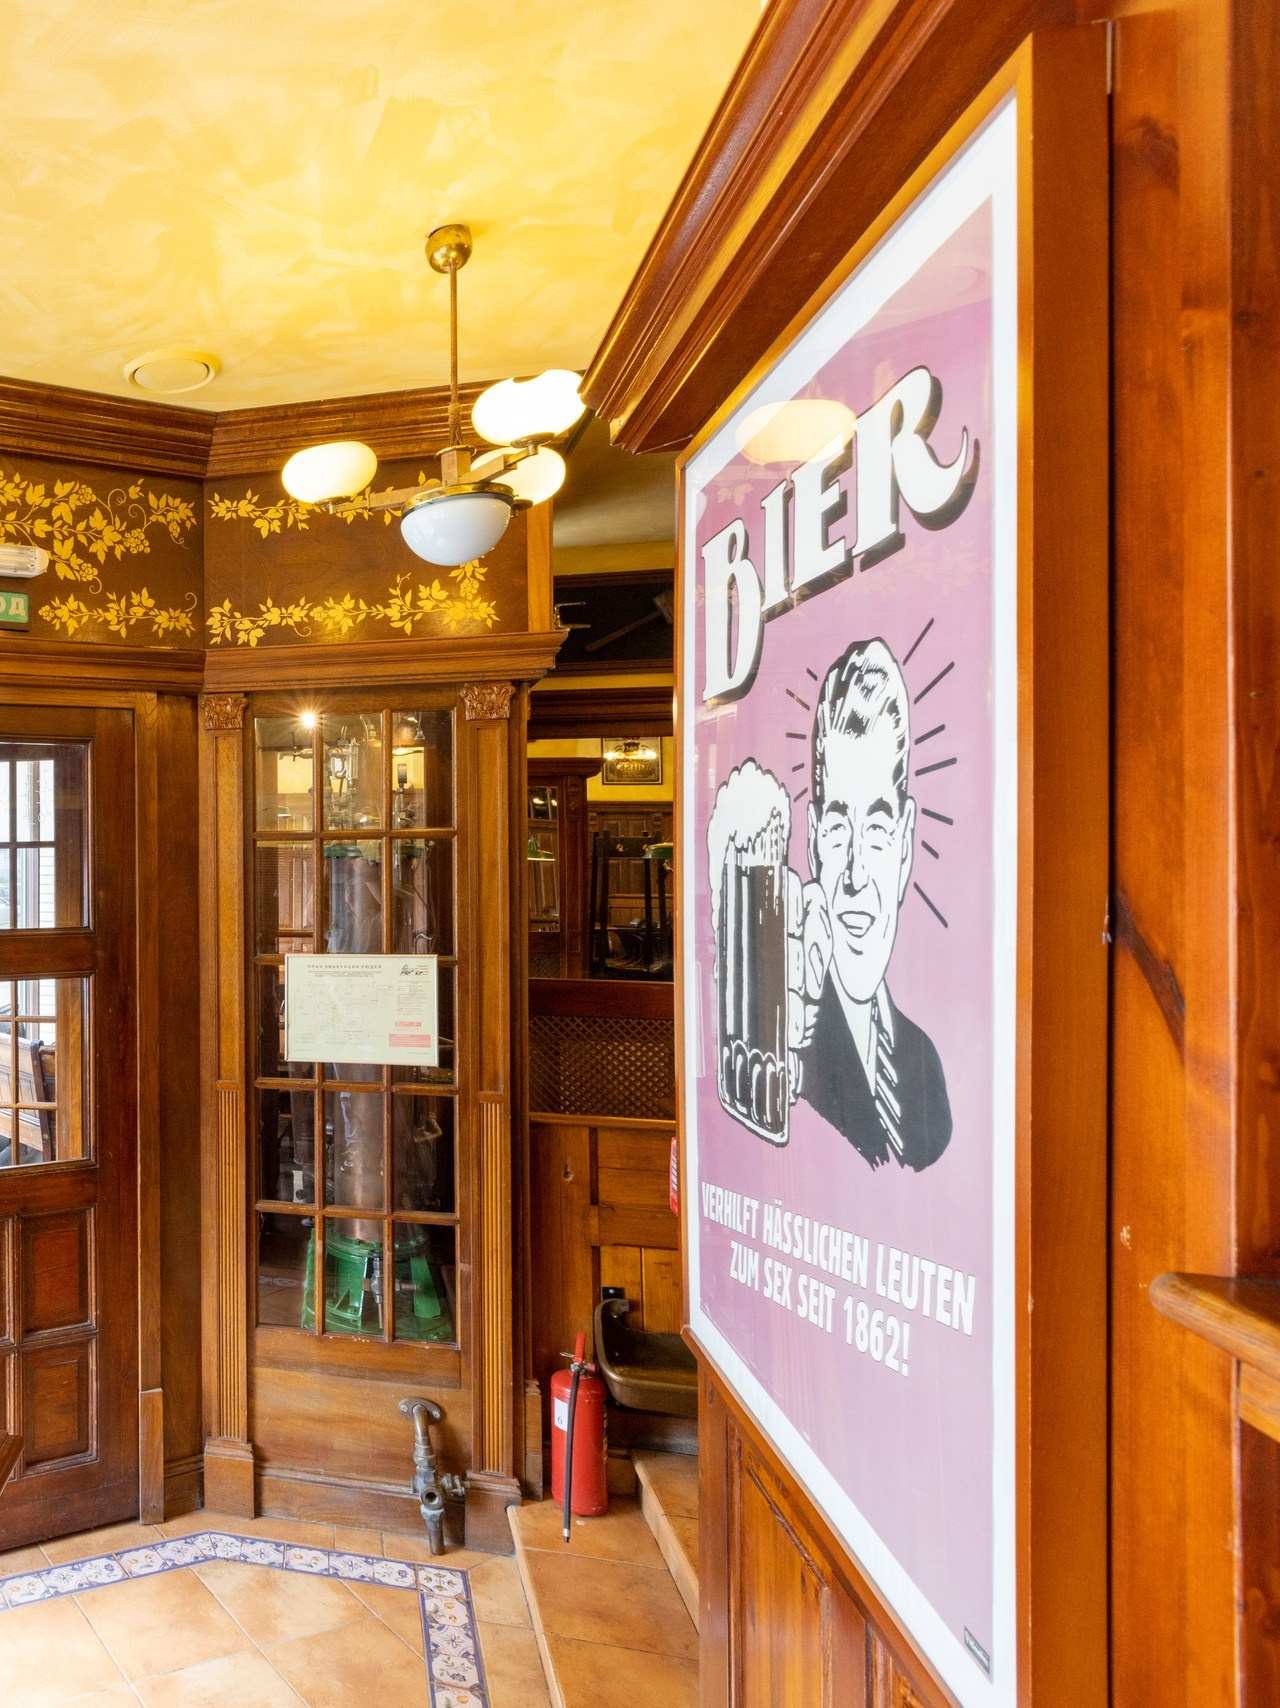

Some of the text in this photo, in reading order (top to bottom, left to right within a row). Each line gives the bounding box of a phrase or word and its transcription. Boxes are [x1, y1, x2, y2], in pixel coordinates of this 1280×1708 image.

[701, 364, 974, 704] BIER
[701, 1181, 976, 1336] VERHILFT HÄSSLICHEN LEUTEN
[730, 1240, 910, 1377] ZUM SEX SEIT 1862!
[557, 1415, 563, 1425] 6
